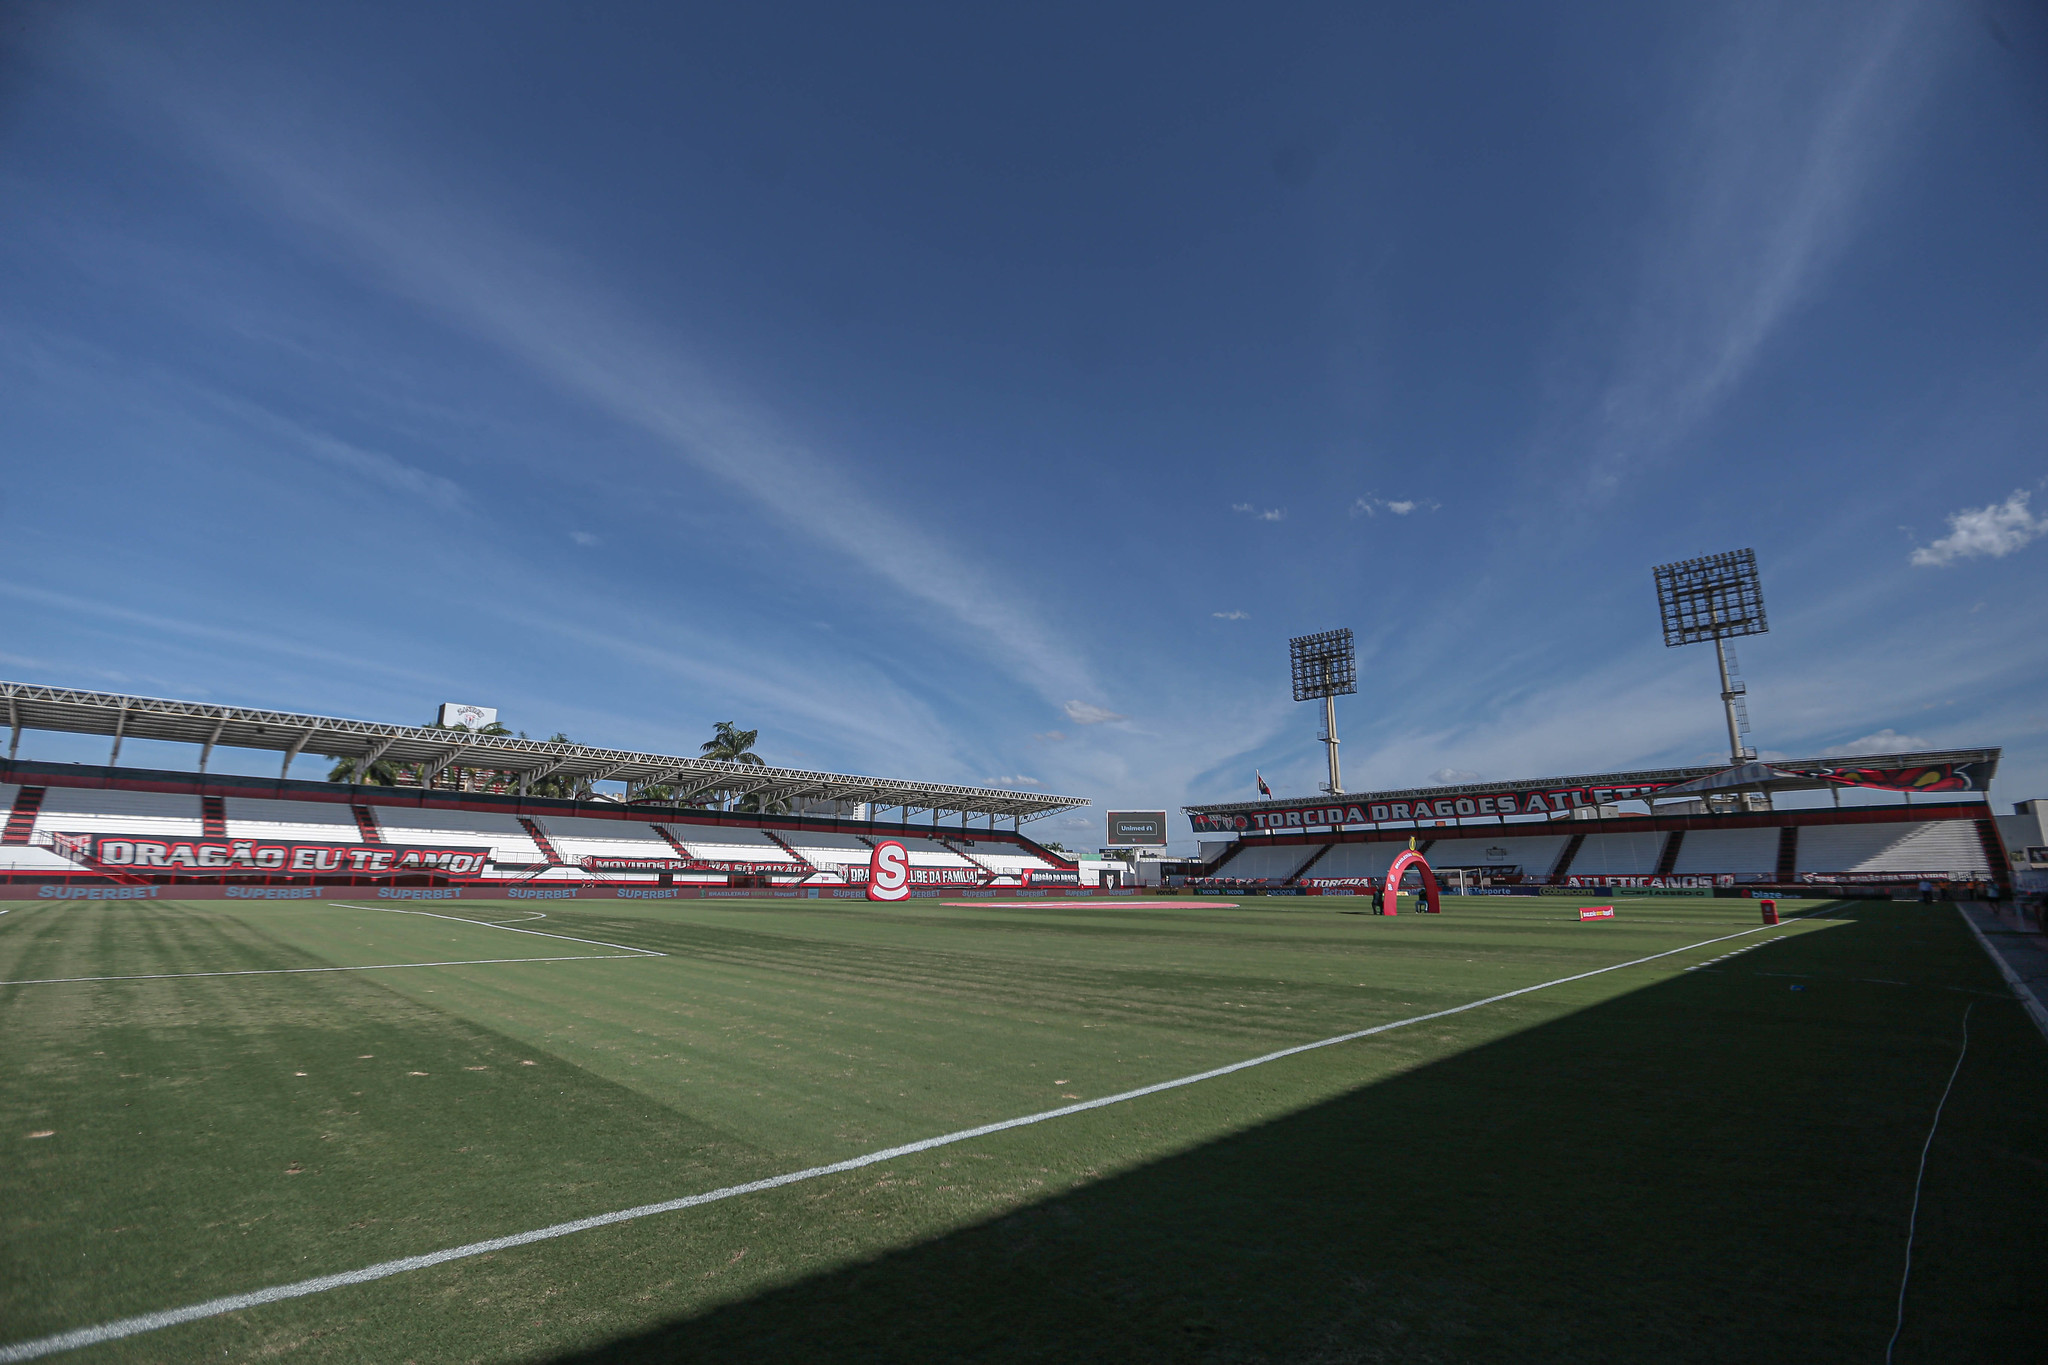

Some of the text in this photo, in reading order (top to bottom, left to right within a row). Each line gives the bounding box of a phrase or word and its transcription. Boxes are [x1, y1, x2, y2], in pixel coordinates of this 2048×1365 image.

[1253, 805, 1364, 829] TORCIDA
[101, 840, 486, 874] DRAGÃO EU TE AMO!
[850, 868, 978, 884] DRA LUBE DA FAMÍLIA!
[1568, 875, 1713, 889] ATLETICANOS
[1313, 878, 1369, 888] TORCIDA
[38, 886, 161, 900] SUPERBET
[225, 886, 324, 899] SUPERBET
[377, 886, 463, 899] SUPERBET
[507, 887, 578, 899] SUPERBET
[617, 887, 679, 899] SUPERBET
[832, 889, 866, 898] SUPERB
[911, 889, 940, 898] PERBET
[962, 889, 998, 898] SUPERBET
[1016, 889, 1048, 898] SUPERBET
[1065, 889, 1094, 897] SUPERBET
[1156, 888, 1179, 896] vonder
[1751, 890, 1783, 899] blaze
